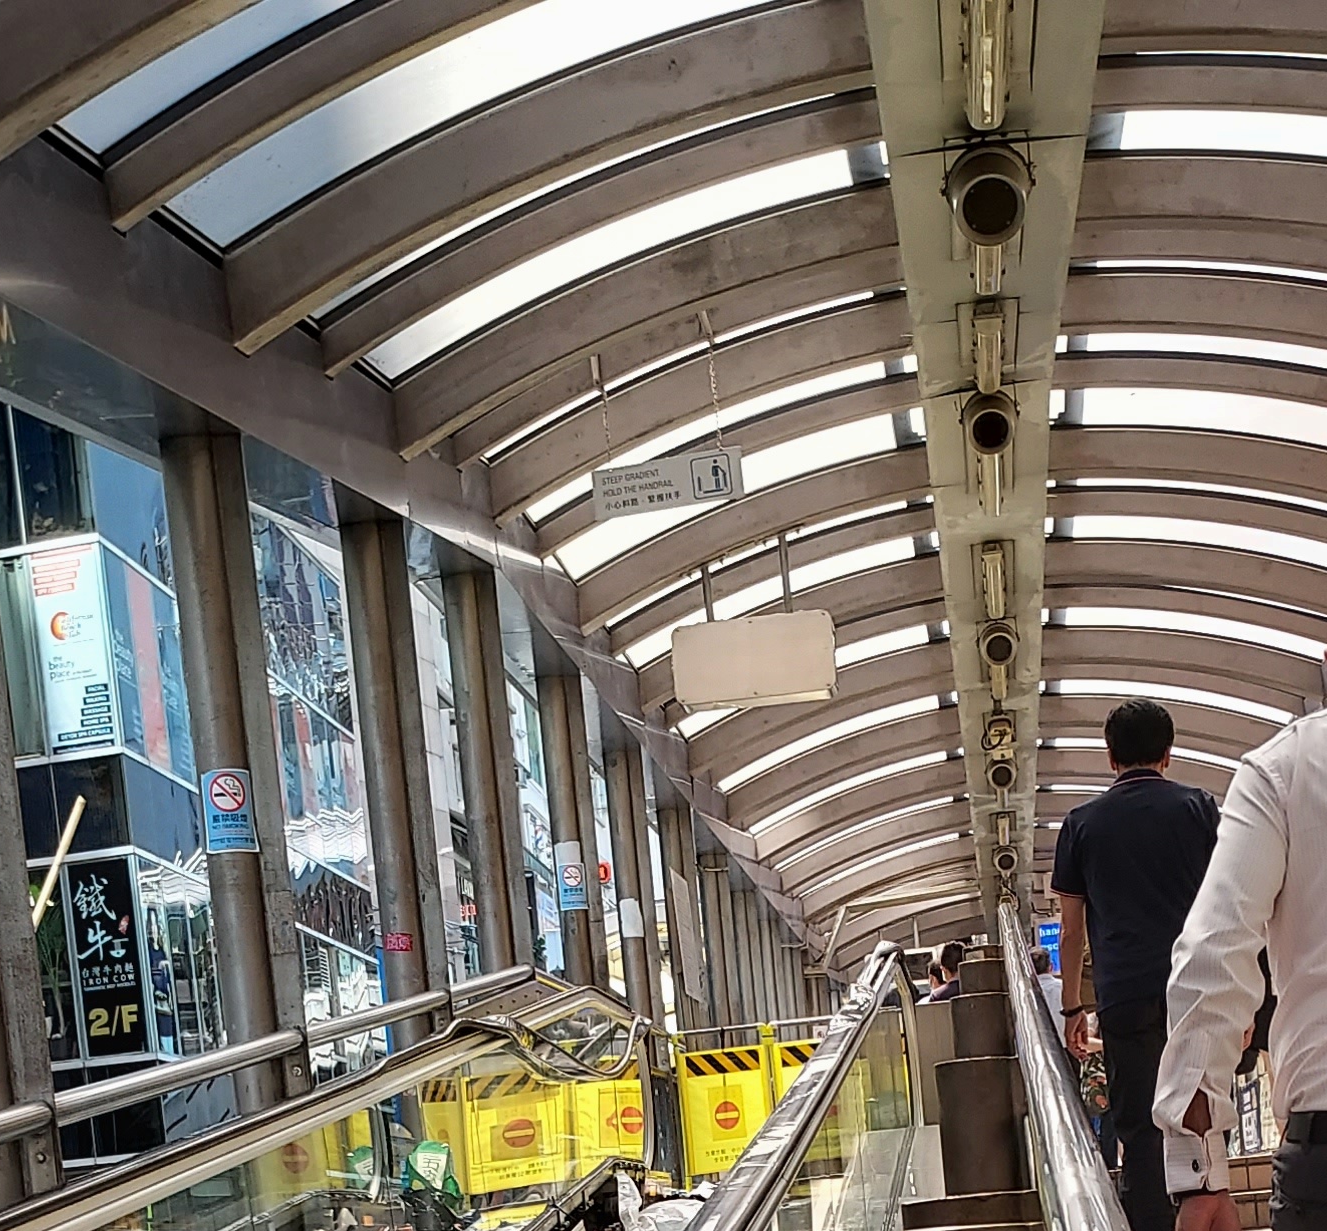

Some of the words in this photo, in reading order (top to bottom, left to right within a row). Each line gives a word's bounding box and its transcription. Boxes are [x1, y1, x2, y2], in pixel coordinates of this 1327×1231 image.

[602, 475, 623, 487] STEEP
[625, 468, 660, 482] GRADIENT
[603, 486, 624, 498] HOLD
[624, 483, 637, 494] THE
[638, 479, 674, 492] HANDRAIL
[83, 976, 109, 987] IRON
[113, 973, 135, 983] COW
[88, 1004, 138, 1037] 2/F
